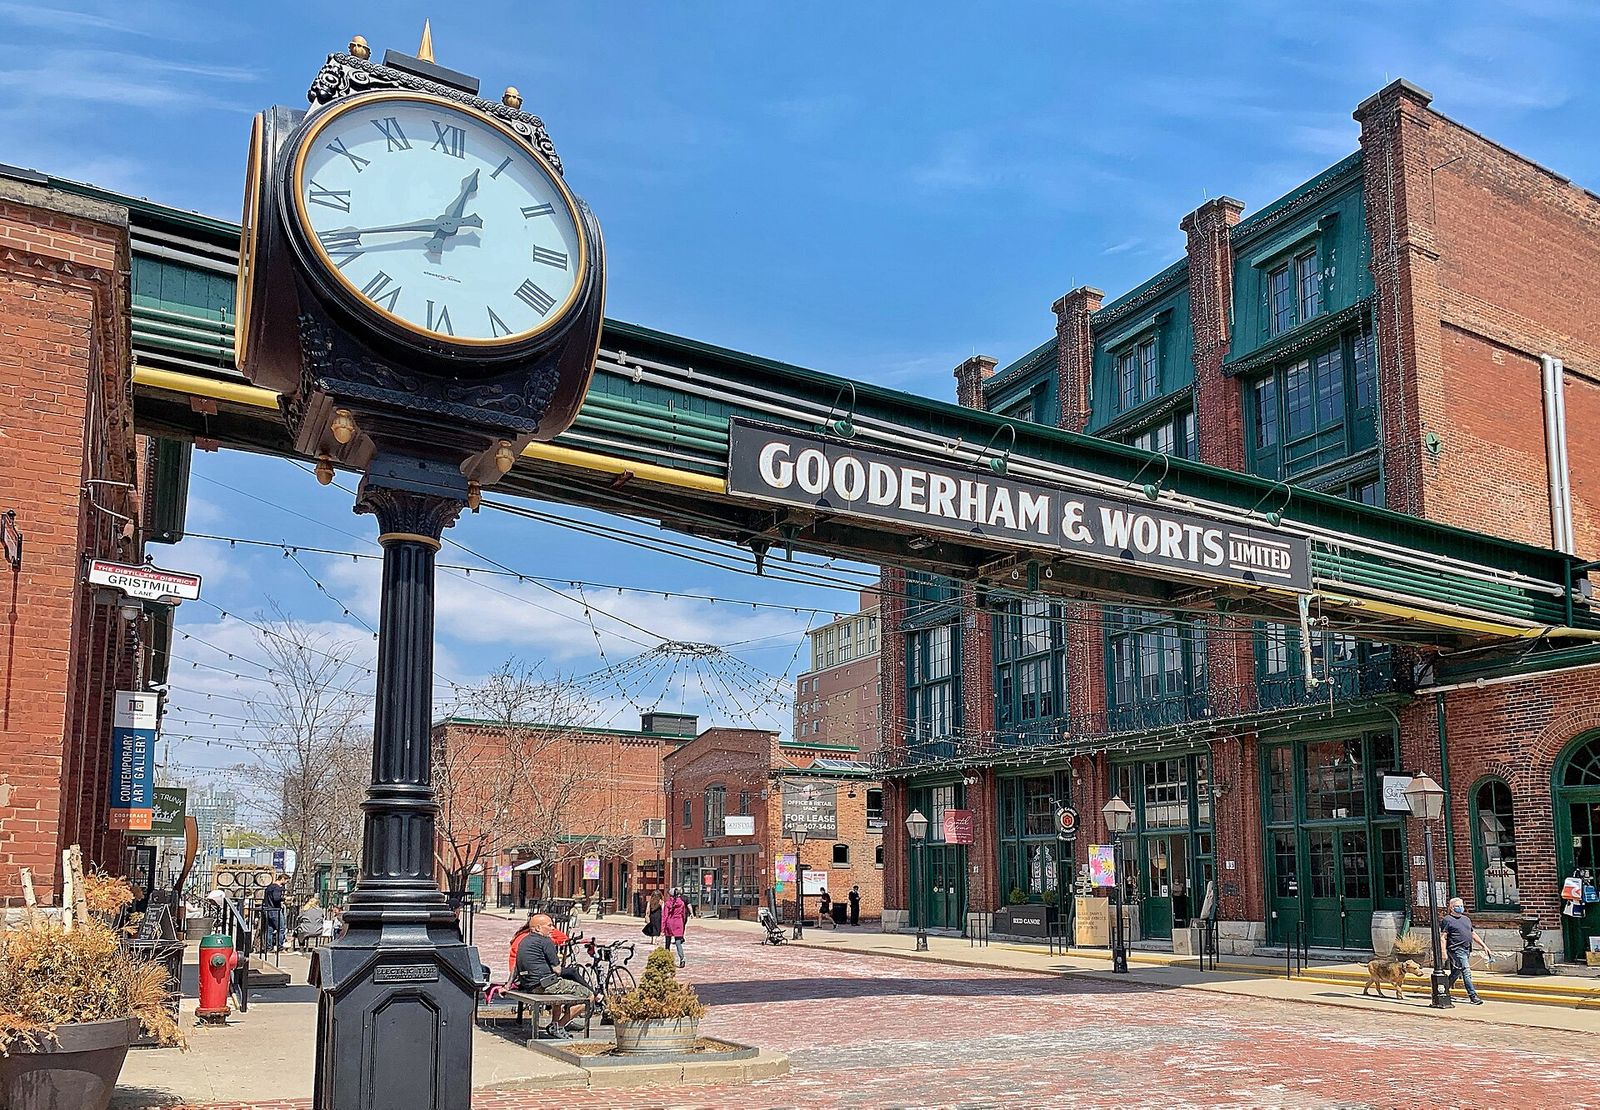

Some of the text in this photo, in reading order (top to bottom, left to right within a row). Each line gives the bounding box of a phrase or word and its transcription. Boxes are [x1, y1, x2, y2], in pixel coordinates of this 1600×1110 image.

[370, 117, 413, 152] XI
[431, 119, 466, 159] XII
[326, 137, 371, 173] X
[489, 156, 513, 180] I
[309, 180, 351, 213] IX
[520, 202, 556, 219] II
[533, 244, 568, 271] III
[513, 278, 557, 317] IIII
[426, 299, 454, 336] VI
[487, 305, 513, 337] V
[758, 440, 1225, 567] GOODERHAM & WORTS
[1228, 540, 1292, 570] LIMITED
[108, 575, 181, 594] GRISTMILL
[115, 568, 158, 580] DISTILLERY
[160, 576, 194, 585] DISTRICT
[120, 734, 133, 802] CONTEMPORARY
[133, 735, 146, 802] ART GALLERY
[160, 793, 184, 806] TRUNK
[785, 814, 835, 823] FOR LEASE
[1486, 869, 1510, 878] MILK
